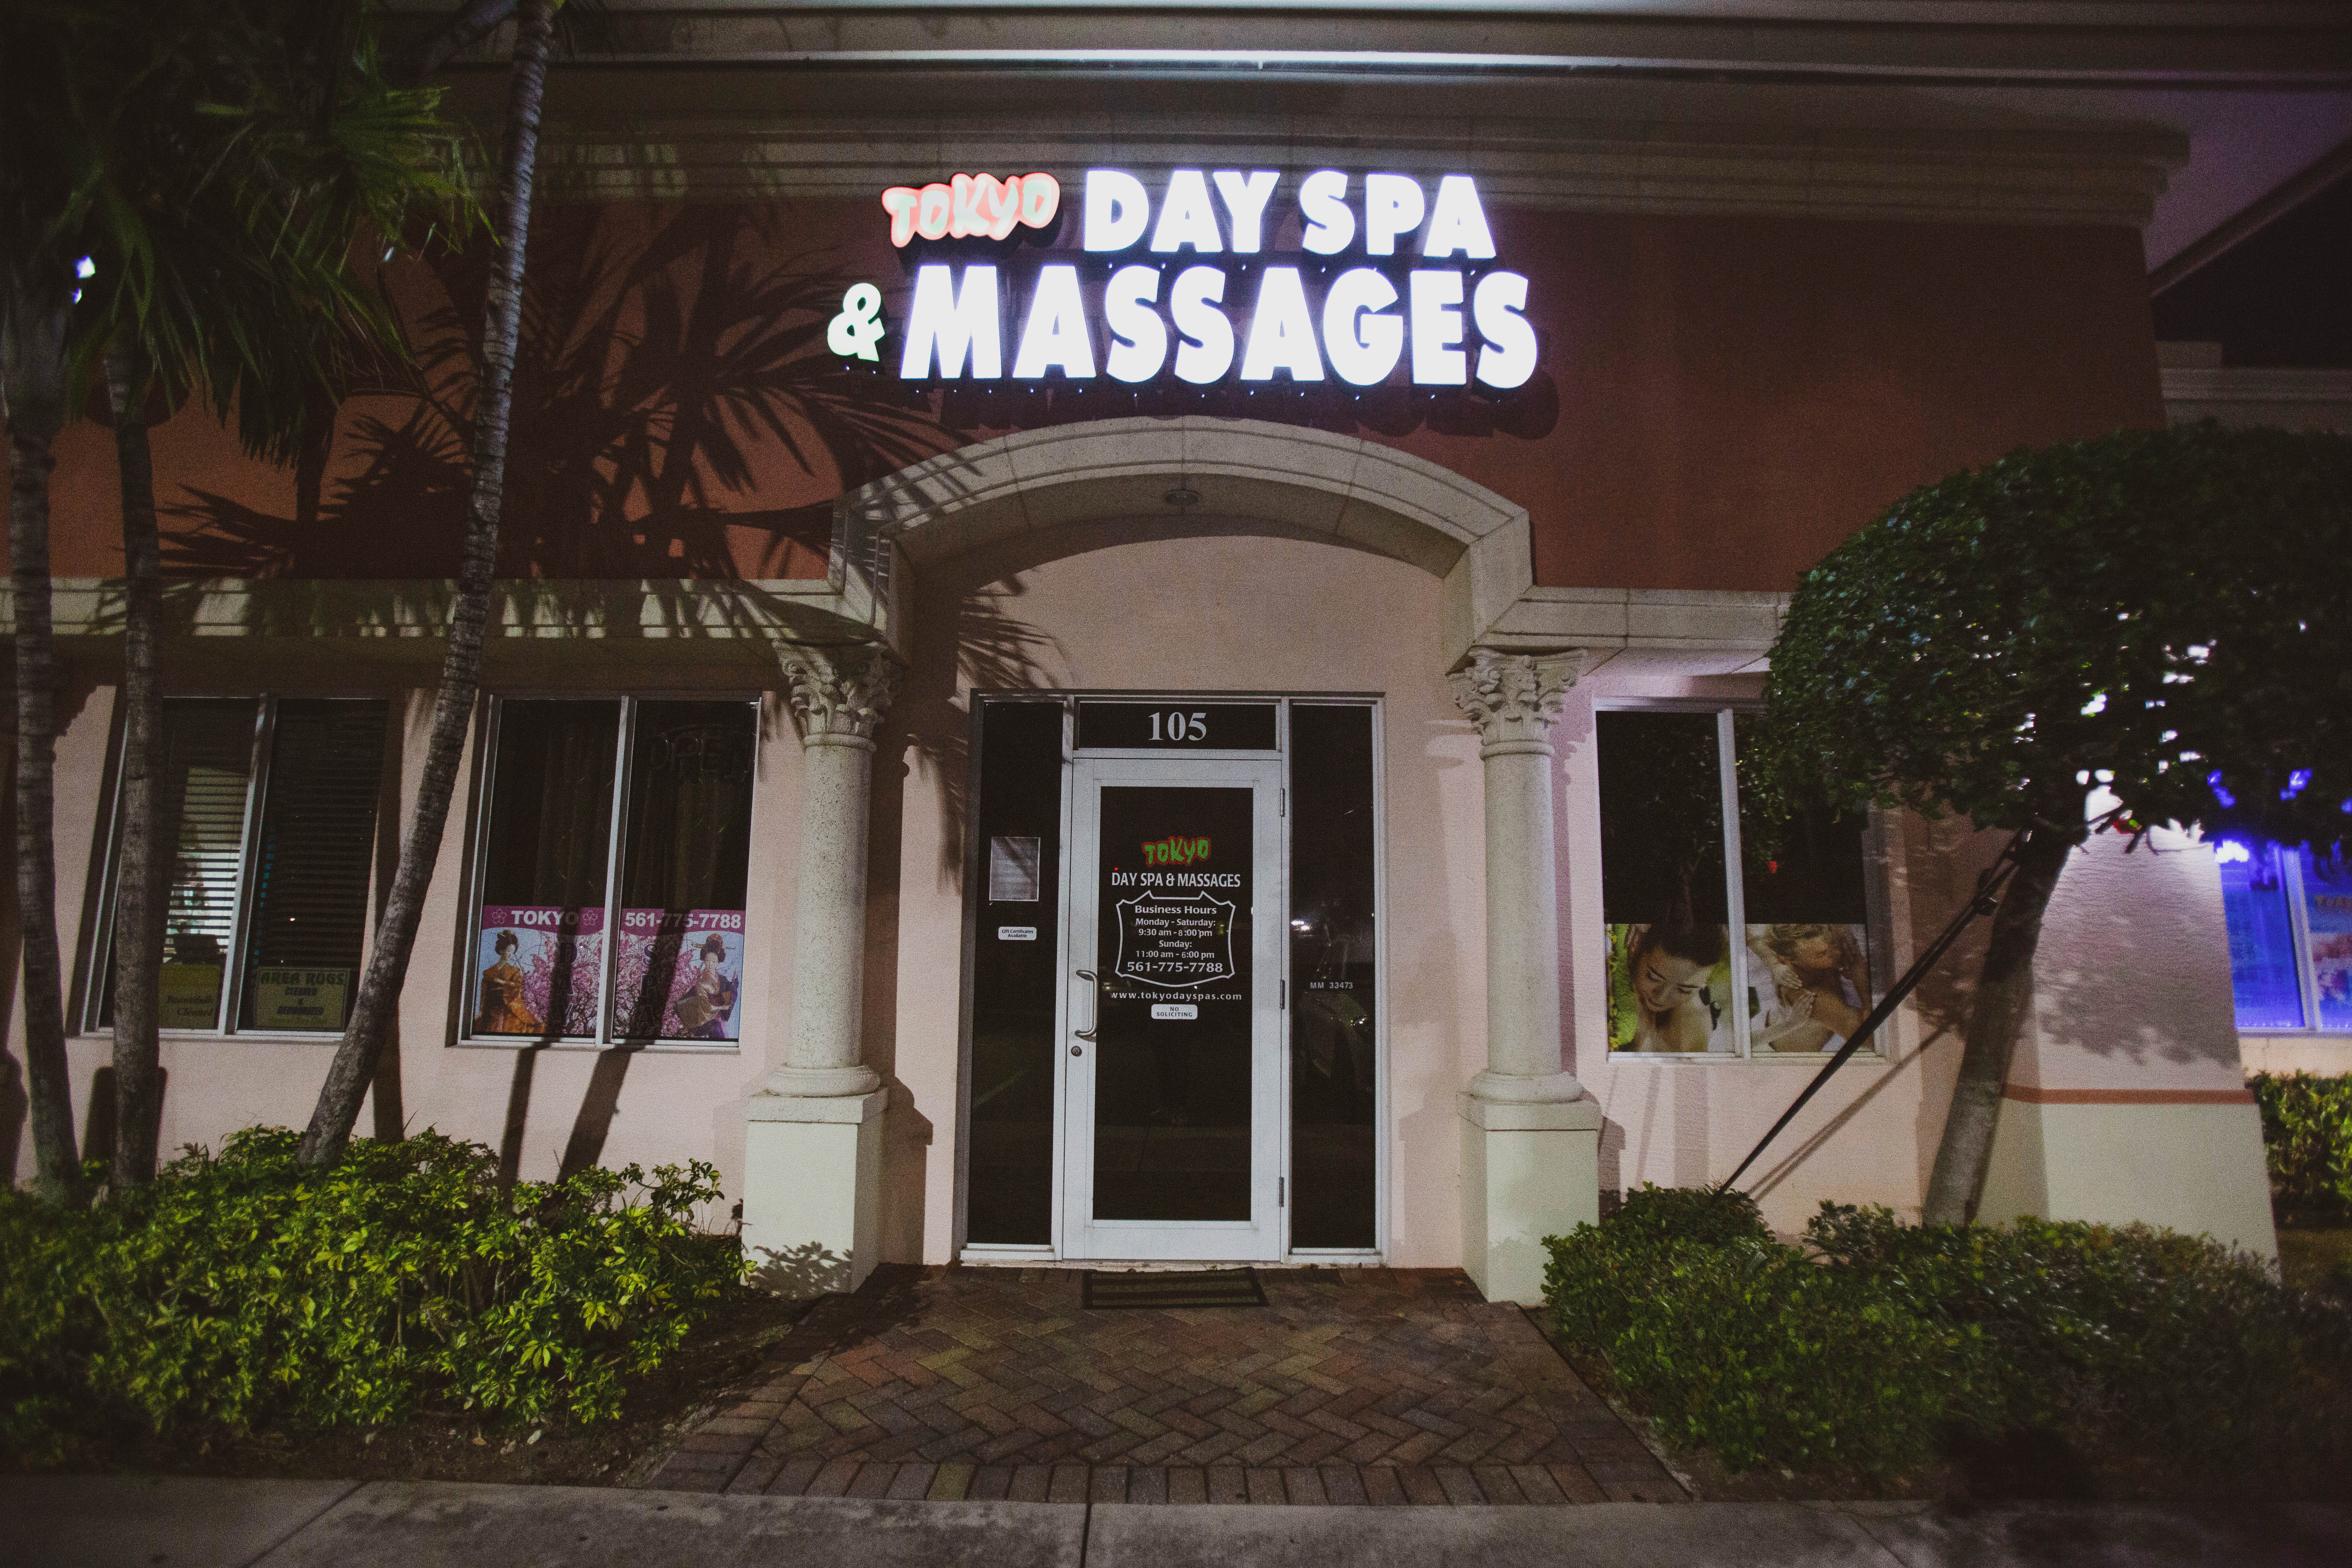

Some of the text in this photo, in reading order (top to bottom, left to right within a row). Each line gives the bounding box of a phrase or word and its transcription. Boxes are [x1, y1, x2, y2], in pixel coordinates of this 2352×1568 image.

[882, 169, 1496, 259] TOKYO DAY SPA
[827, 264, 1538, 389] & MASSAGES
[1148, 712, 1207, 741] 105
[1142, 836, 1211, 867] TOKYO
[1112, 873, 1241, 887] DAY SPA & MASSAGES
[1135, 905, 1181, 913] Business
[511, 910, 741, 928] TOKYO 561-775-7788
[1136, 918, 1169, 927] Monday
[1176, 919, 1216, 928] Saturday:
[1198, 930, 1212, 938] pm
[1159, 940, 1192, 949] Sunday:
[1127, 962, 1223, 972] 561-775-7788
[1110, 992, 1242, 1001] www.tokyodayspas.com
